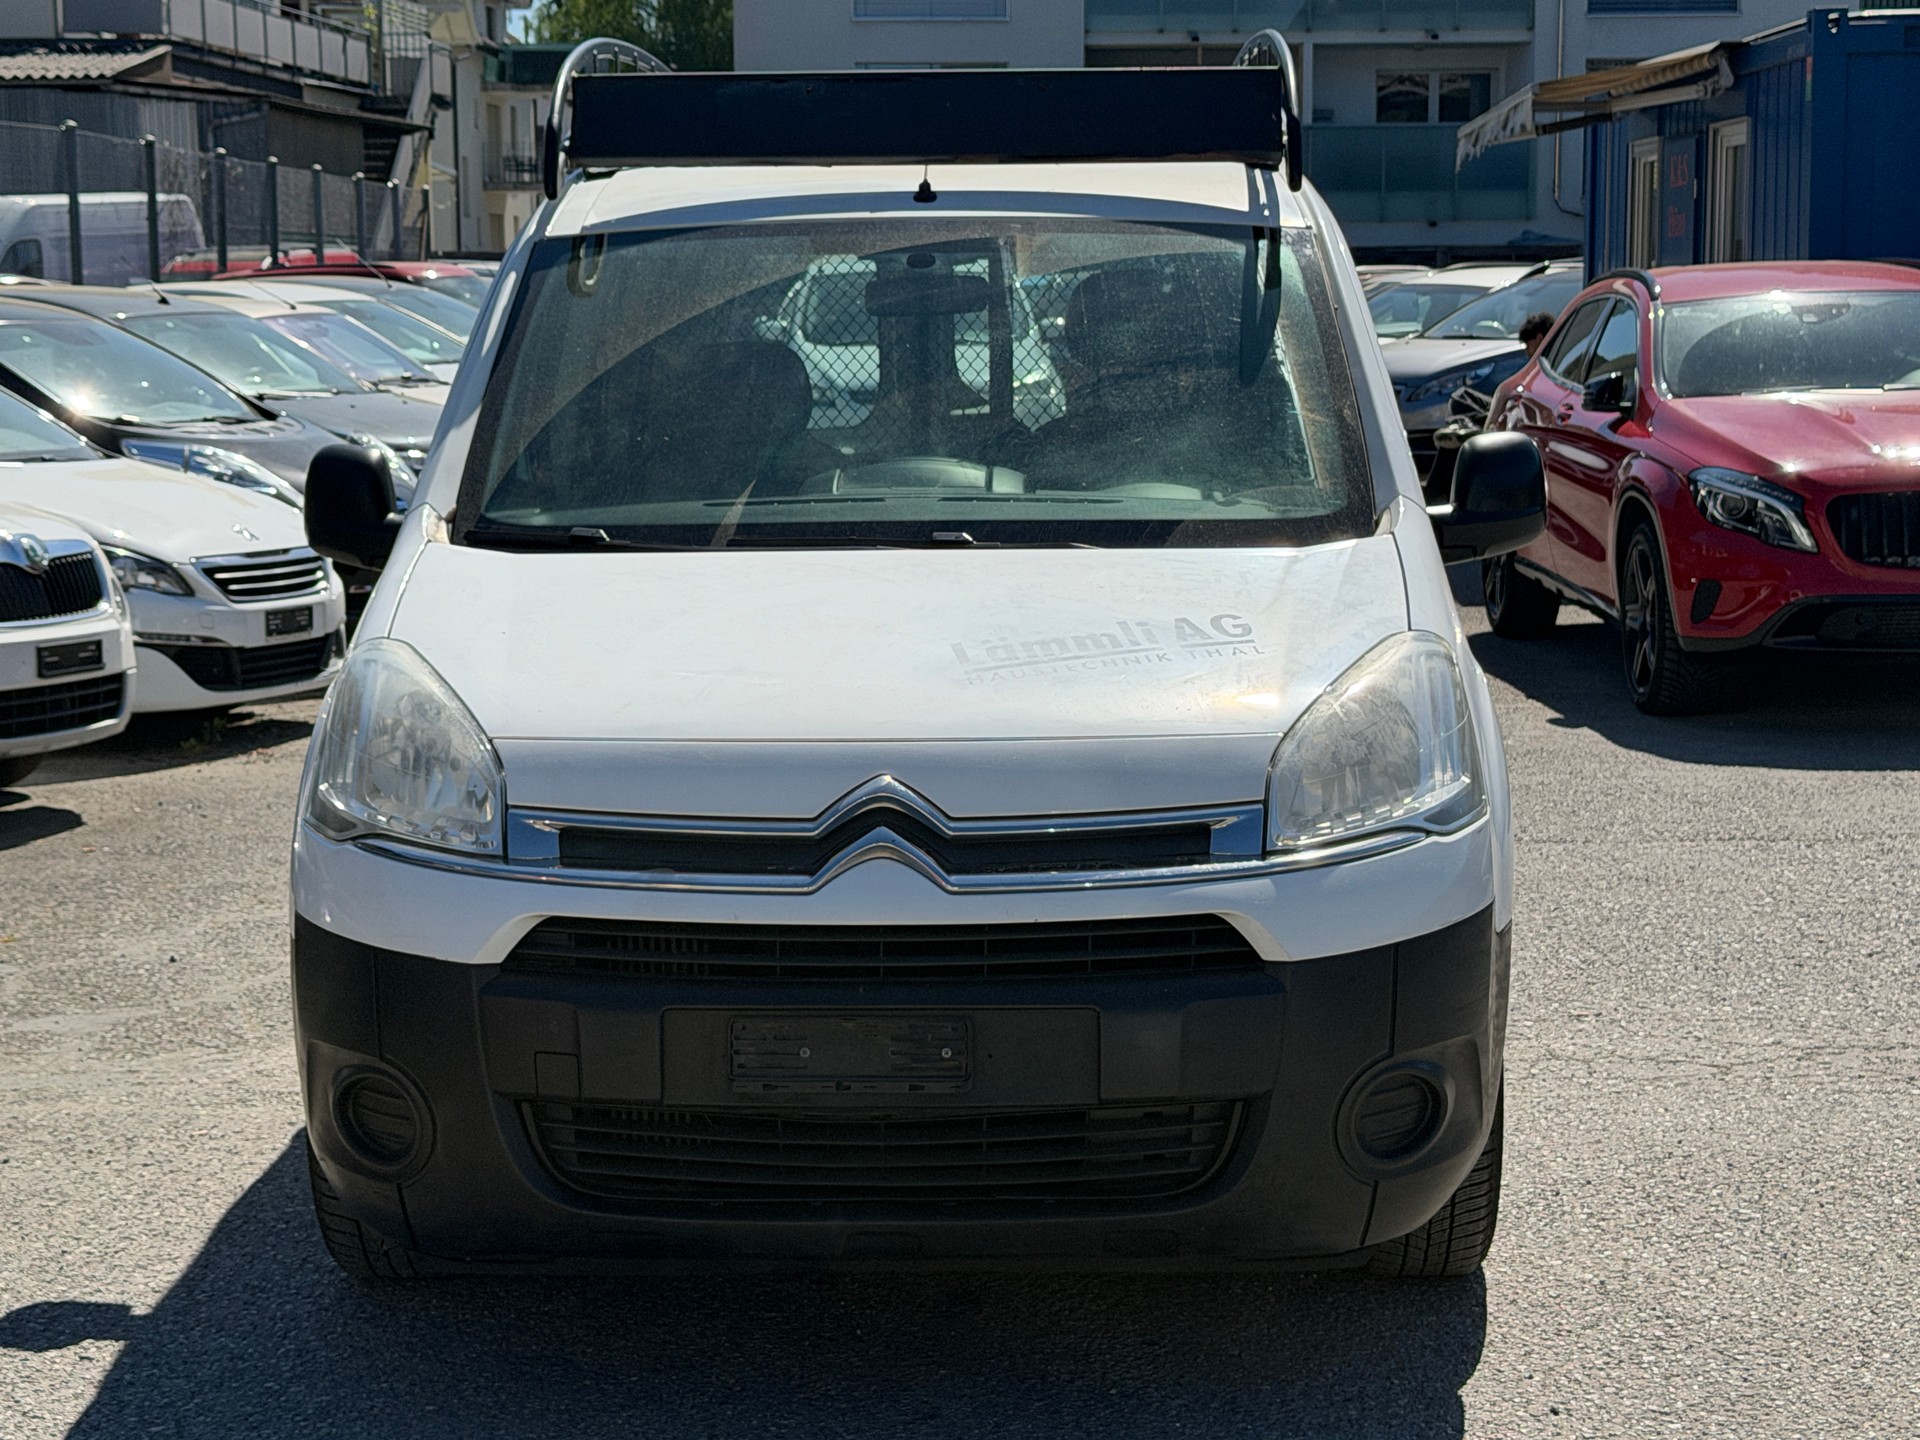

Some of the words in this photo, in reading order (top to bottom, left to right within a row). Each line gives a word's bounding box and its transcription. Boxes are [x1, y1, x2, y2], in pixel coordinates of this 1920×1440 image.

[952, 620, 1158, 665] Lämmli
[1173, 614, 1253, 641] AG
[967, 652, 1171, 685] HAUSTECHNIK
[1188, 645, 1265, 660] THAL
